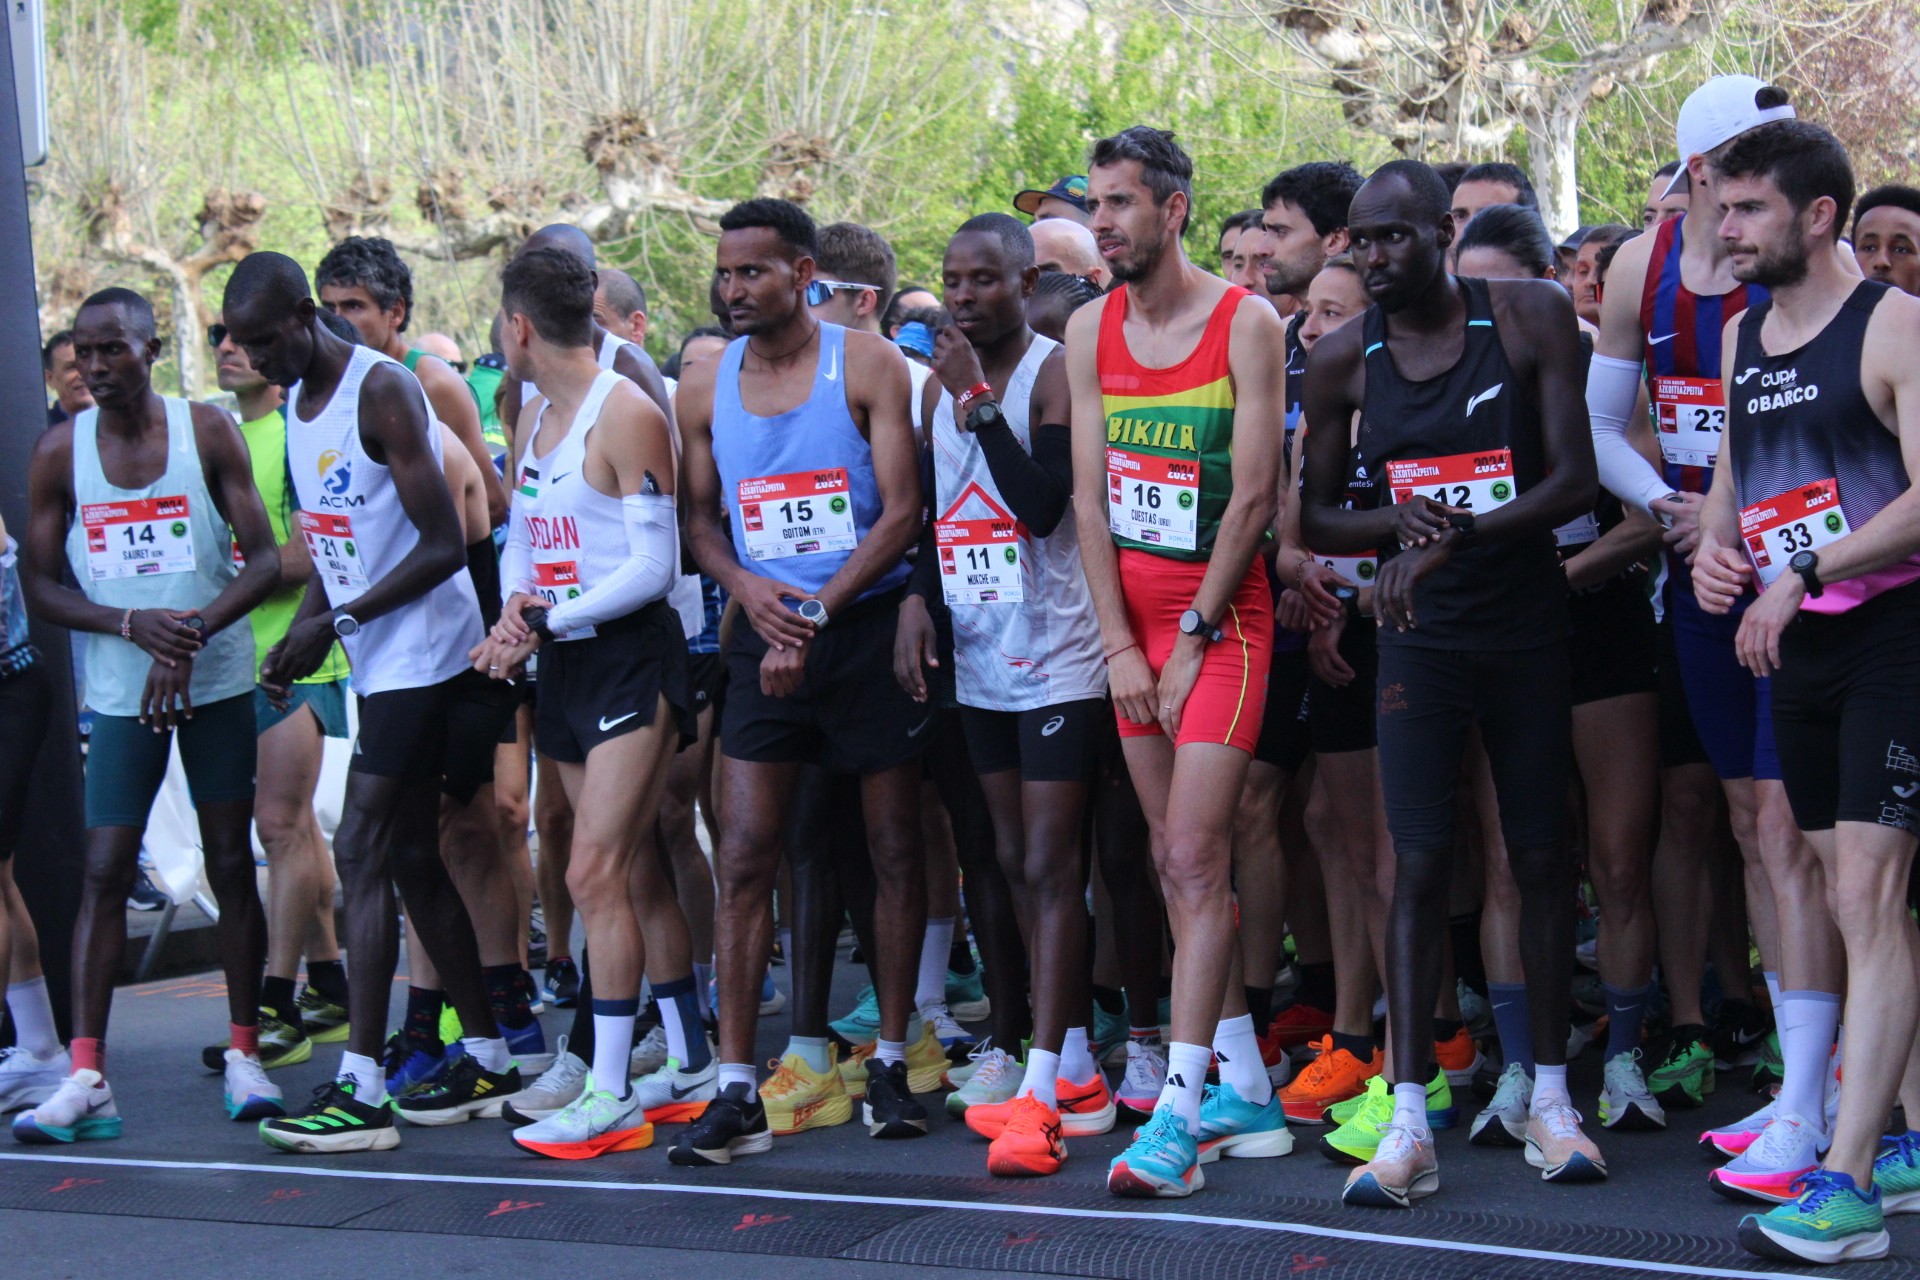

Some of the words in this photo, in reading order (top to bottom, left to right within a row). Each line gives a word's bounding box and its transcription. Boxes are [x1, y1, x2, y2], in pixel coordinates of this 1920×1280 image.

[1761, 368, 1797, 387] CUPA
[1108, 417, 1197, 451] BIKILA
[1167, 463, 1195, 481] 2024
[1474, 454, 1506, 474] 2024
[814, 471, 843, 489] 2024
[319, 495, 366, 508] ACM
[1134, 483, 1161, 509] 16
[1434, 485, 1473, 508] 12
[157, 499, 185, 515] 2024
[780, 500, 813, 523] 15
[1131, 509, 1157, 526] CUESTAS
[123, 524, 156, 546] 14
[782, 526, 811, 539] GOITOM
[991, 523, 1014, 538] 2024
[1778, 522, 1812, 553] 33
[122, 549, 149, 560] SAUREY
[320, 537, 339, 558] 21
[966, 547, 990, 570] 11
